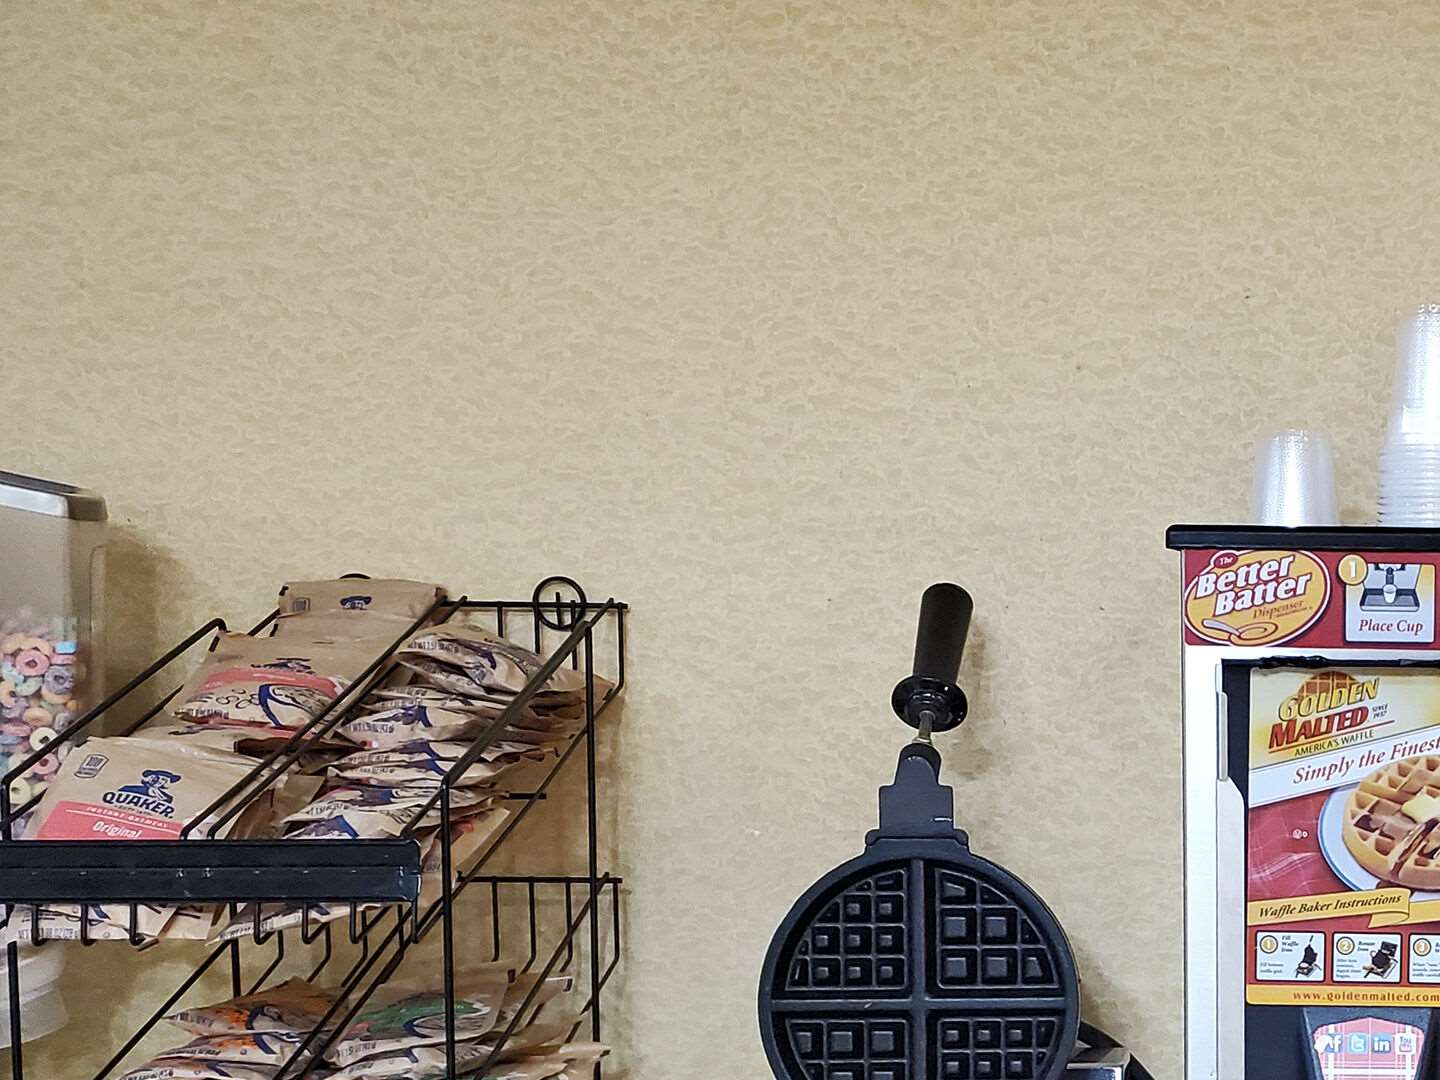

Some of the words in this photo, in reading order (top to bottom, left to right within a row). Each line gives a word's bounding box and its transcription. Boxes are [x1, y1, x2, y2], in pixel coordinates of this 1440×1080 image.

[1219, 556, 1234, 566] The
[1347, 560, 1358, 578] 1
[1195, 554, 1295, 600] Better
[1213, 572, 1313, 617] Batter
[1252, 600, 1304, 619] Dispenser
[1358, 619, 1394, 632] Place
[1396, 619, 1424, 636] Cup
[1278, 678, 1381, 722] GOLDEN
[1268, 706, 1370, 749] MALTED
[1294, 737, 1341, 757] AMERICA'S
[1341, 729, 1375, 745] WAFFLE
[1292, 755, 1356, 785] Simply
[1358, 749, 1387, 769] the
[102, 792, 176, 818] QUAKER
[92, 821, 144, 838] Original
[1259, 904, 1297, 919] Waffle
[1298, 901, 1333, 914] Baker
[1334, 894, 1402, 910] Instructions
[1293, 991, 1440, 1003] www.goldenmalted.com
